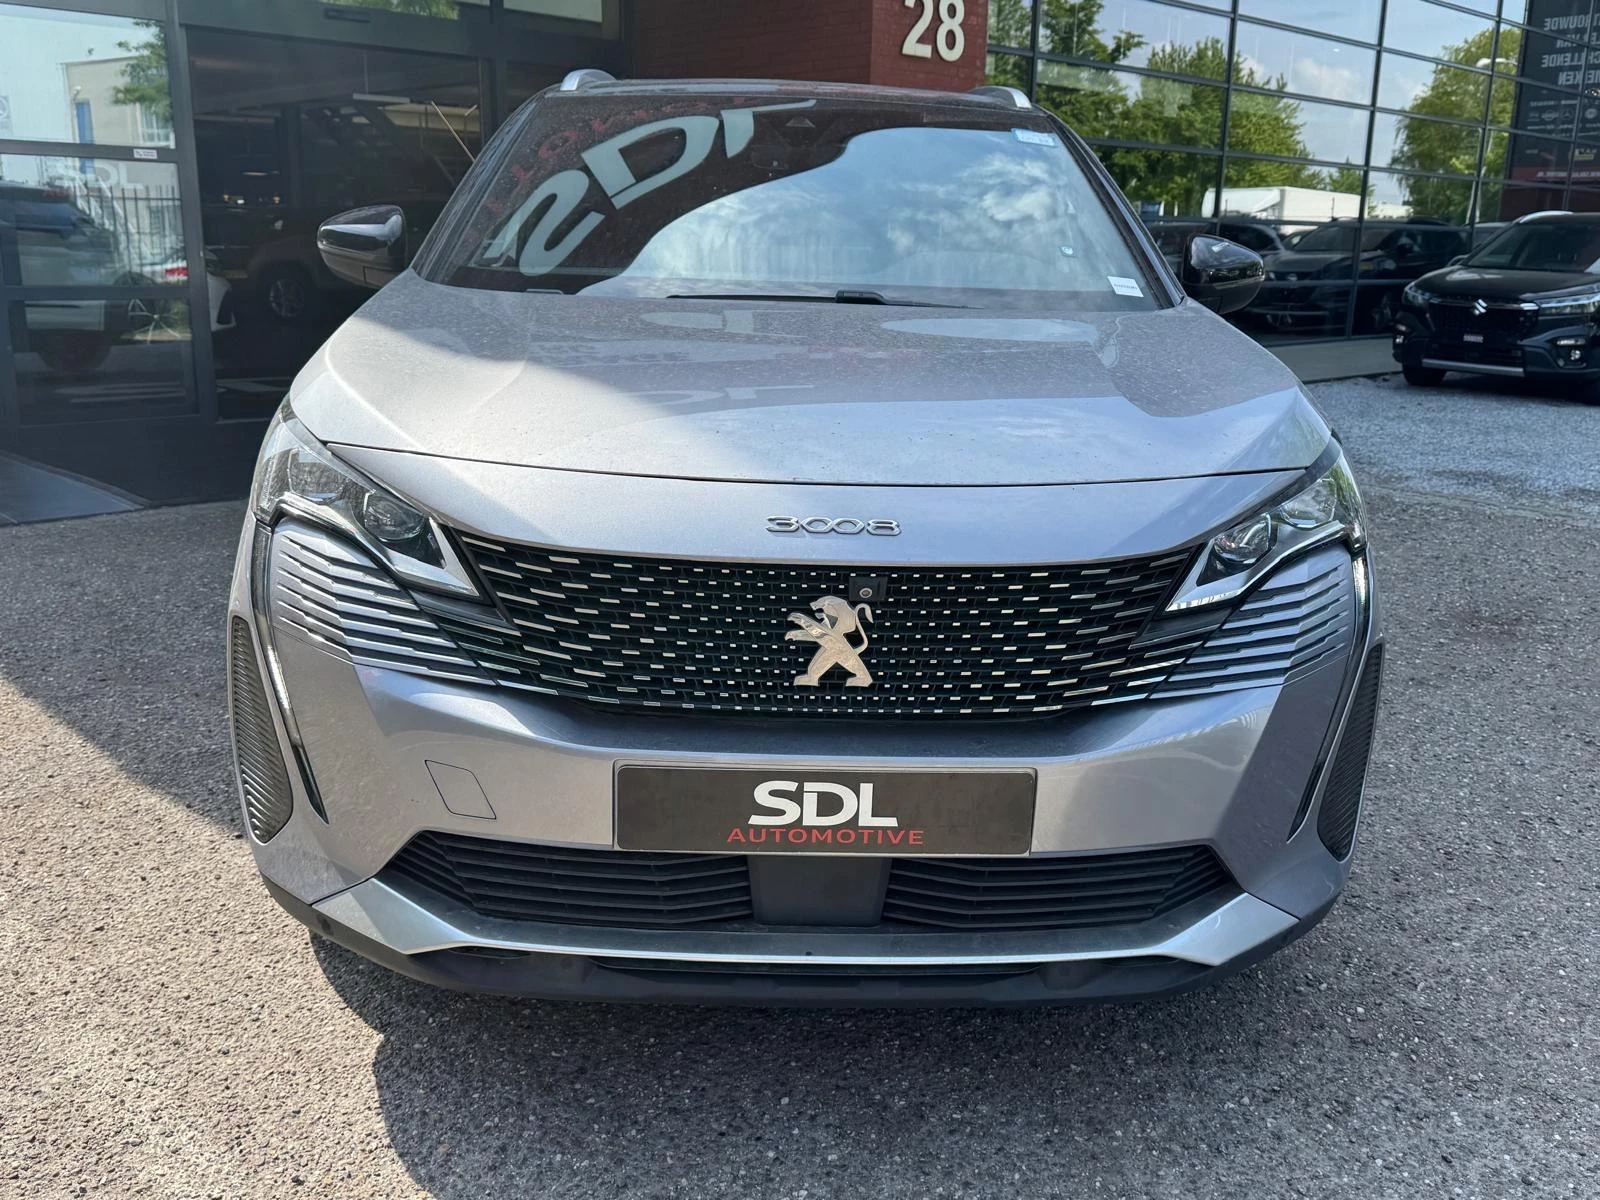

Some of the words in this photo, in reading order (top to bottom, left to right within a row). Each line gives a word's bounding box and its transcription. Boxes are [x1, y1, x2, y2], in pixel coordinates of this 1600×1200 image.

[902, 0, 965, 62] 28
[766, 515, 902, 536] 3008
[748, 780, 899, 828] SDL
[727, 827, 926, 846] AUTOMOTIVE
